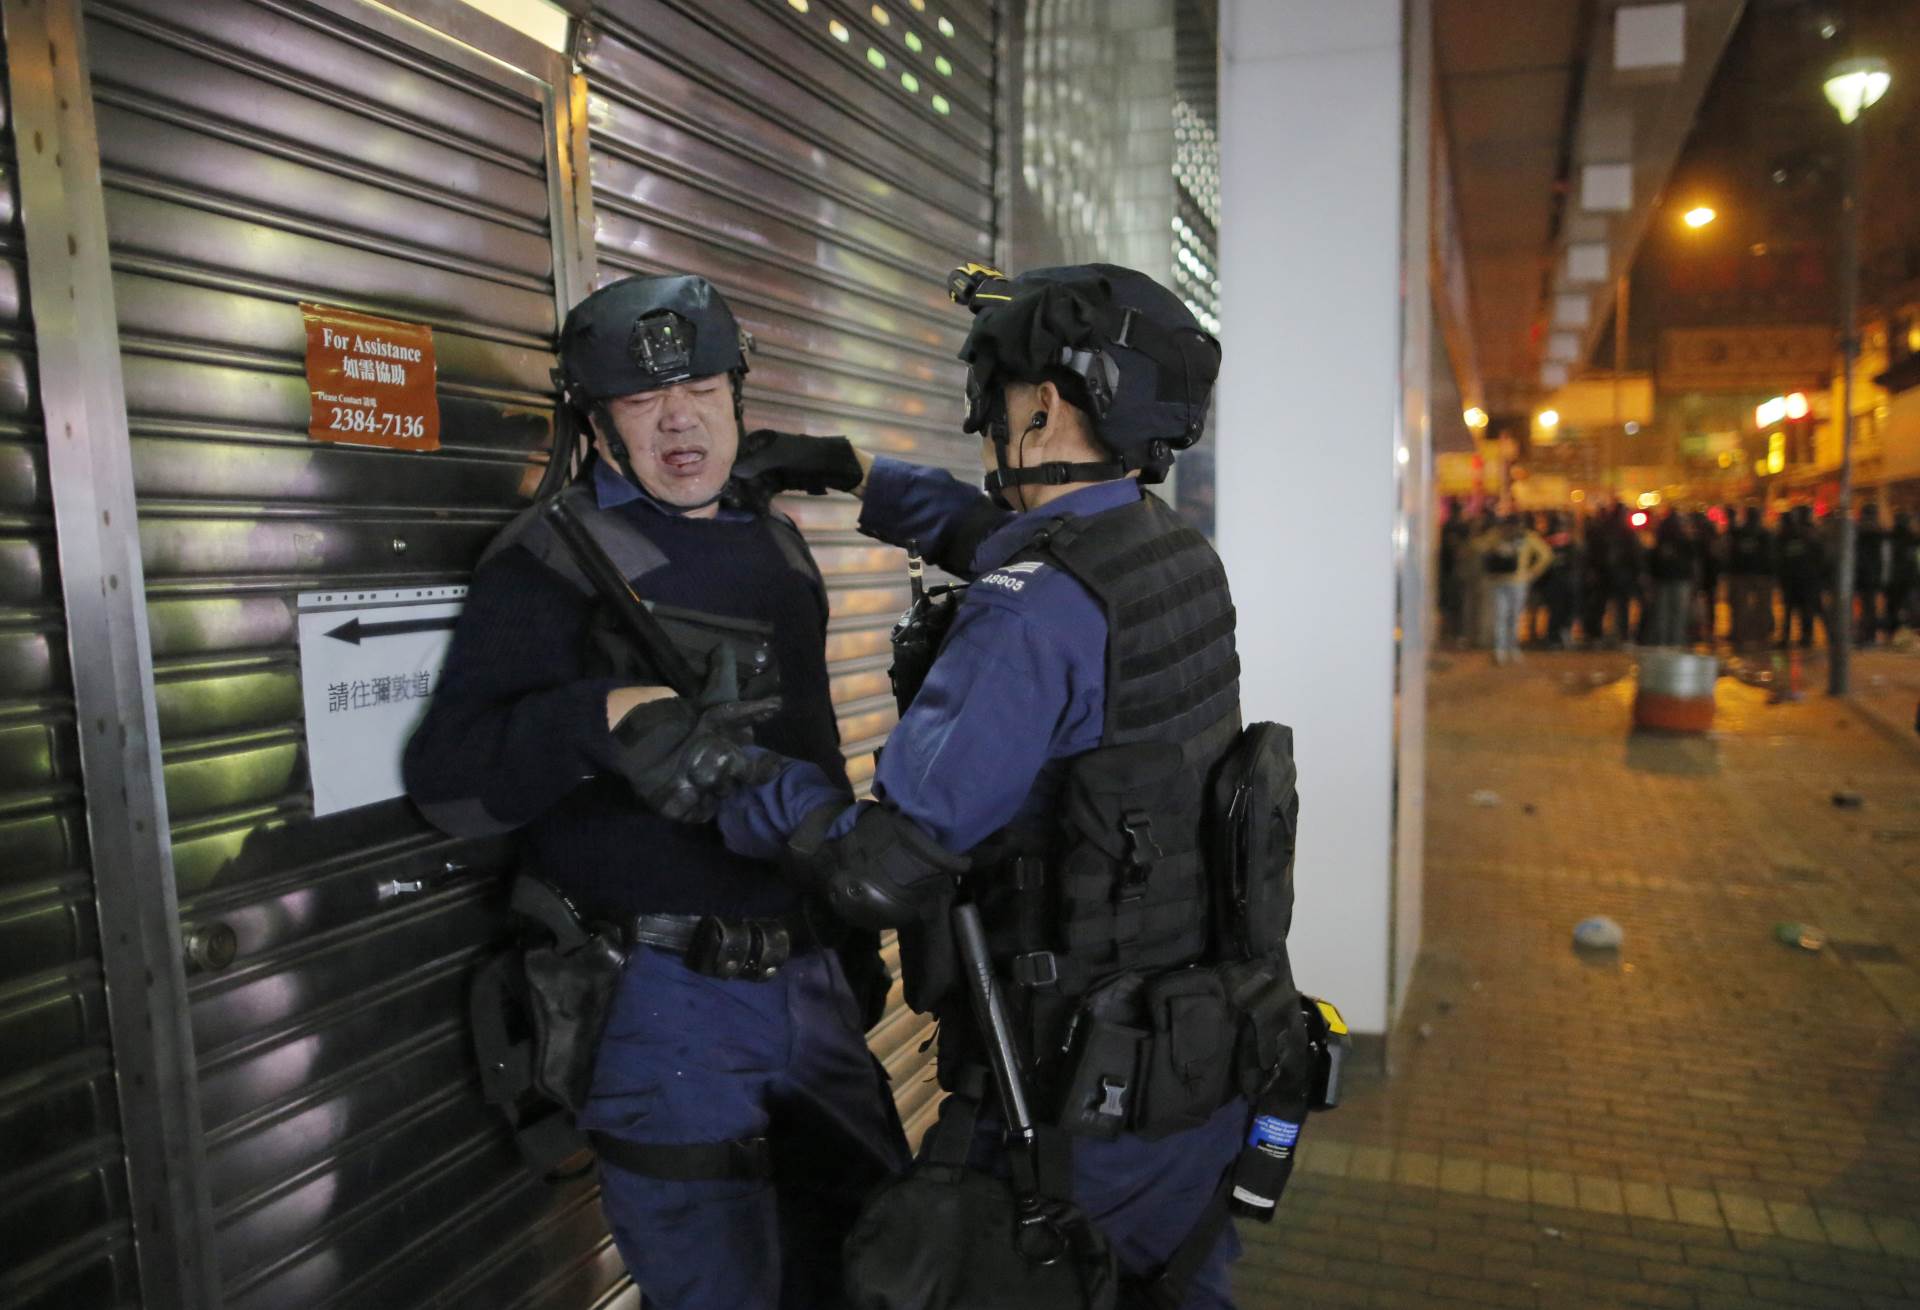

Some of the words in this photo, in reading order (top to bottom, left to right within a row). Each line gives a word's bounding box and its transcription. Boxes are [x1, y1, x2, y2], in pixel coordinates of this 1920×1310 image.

[322, 327, 349, 350] For
[353, 335, 421, 362] Assistance
[342, 355, 405, 386] 如需協助
[329, 407, 424, 437] 2384-7136
